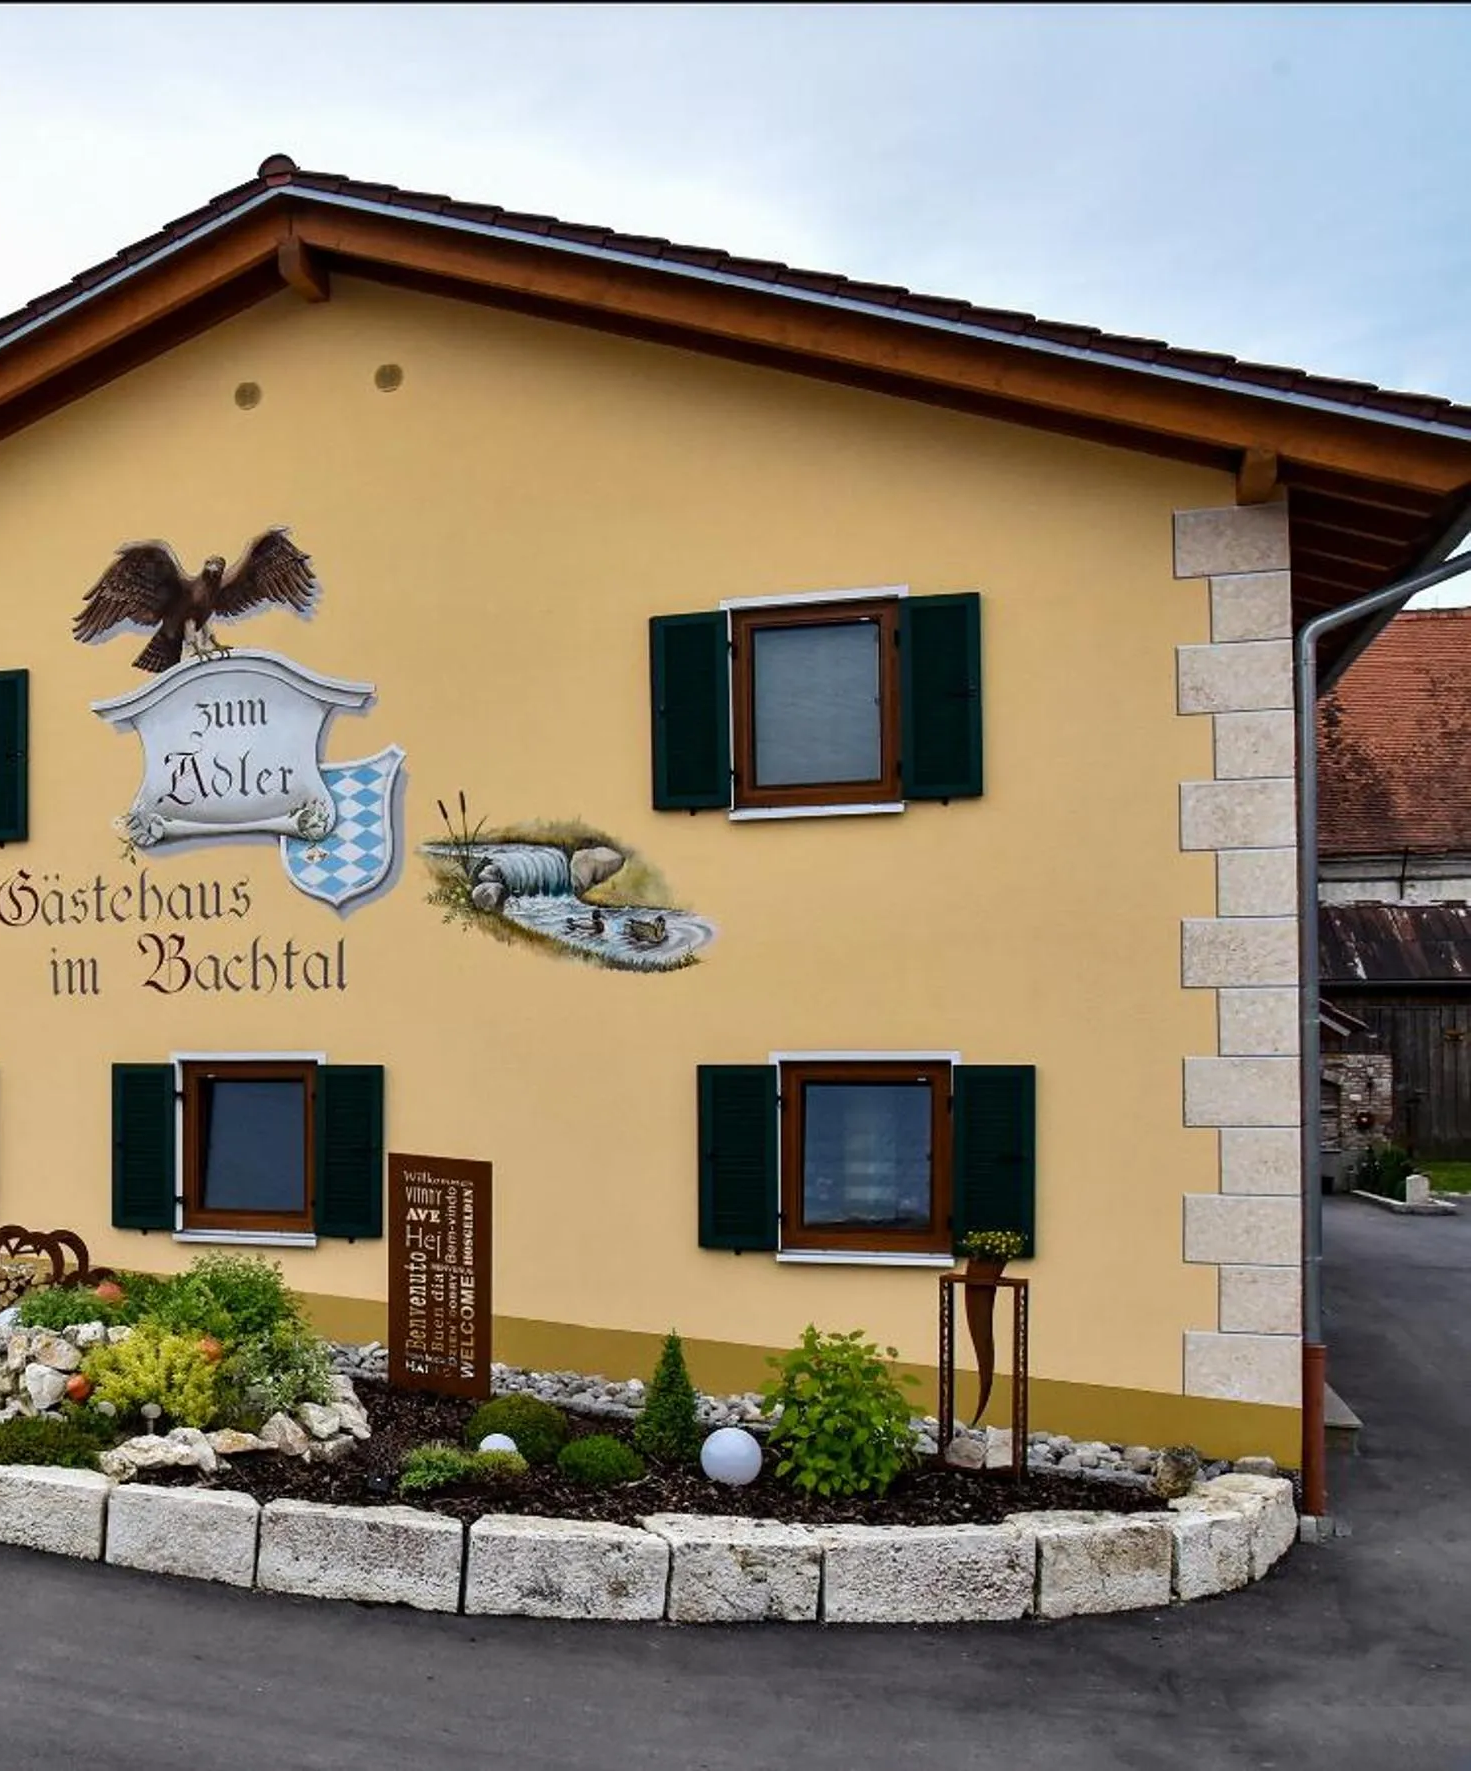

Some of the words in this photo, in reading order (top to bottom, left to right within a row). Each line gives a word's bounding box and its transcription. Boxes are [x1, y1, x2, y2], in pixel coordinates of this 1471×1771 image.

[190, 698, 269, 742] zum
[157, 750, 294, 806] Adler
[50, 947, 101, 996] im
[137, 931, 349, 995] Bachtal
[405, 1207, 441, 1223] AVE
[405, 1224, 442, 1259] Hej
[404, 1251, 427, 1352] Benvenuto
[460, 1275, 476, 1378] WELCOME
